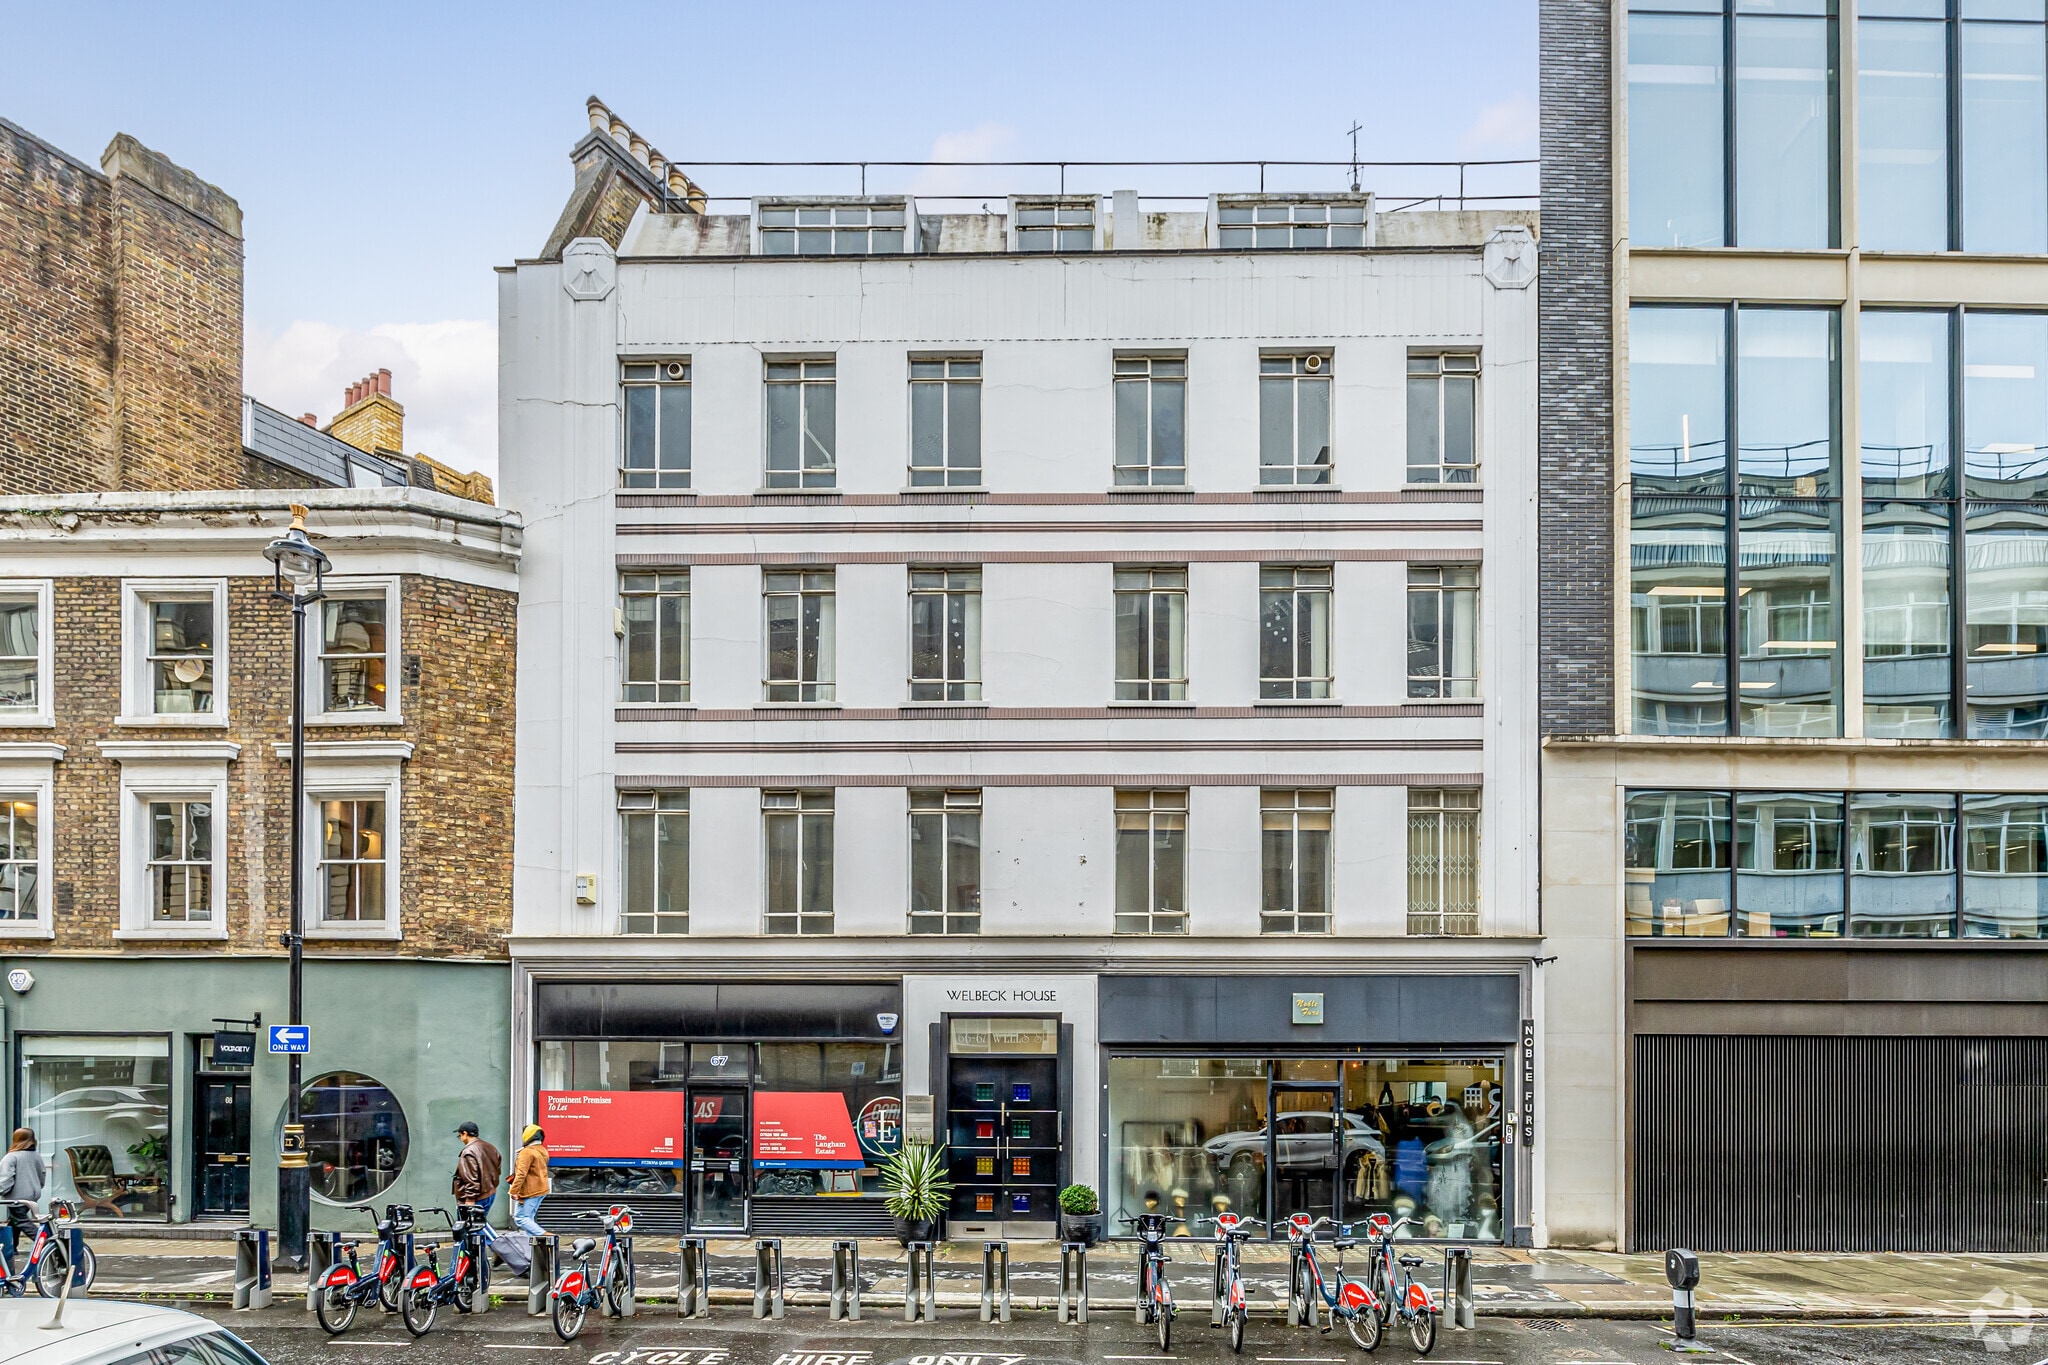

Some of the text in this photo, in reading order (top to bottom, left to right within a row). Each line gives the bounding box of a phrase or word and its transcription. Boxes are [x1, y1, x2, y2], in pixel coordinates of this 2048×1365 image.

[946, 990, 1056, 1002] WELBECK HOUSE
[1296, 999, 1318, 1007] Noble
[710, 1056, 728, 1066] 67
[1524, 1026, 1533, 1136] NOBLE FURS
[548, 1095, 612, 1104] Prominent Premises
[548, 1103, 568, 1111] To Let
[877, 1109, 896, 1143] E
[815, 1141, 846, 1149] Langham
[588, 1352, 1027, 1365] CYCLE HIRE ONLY
